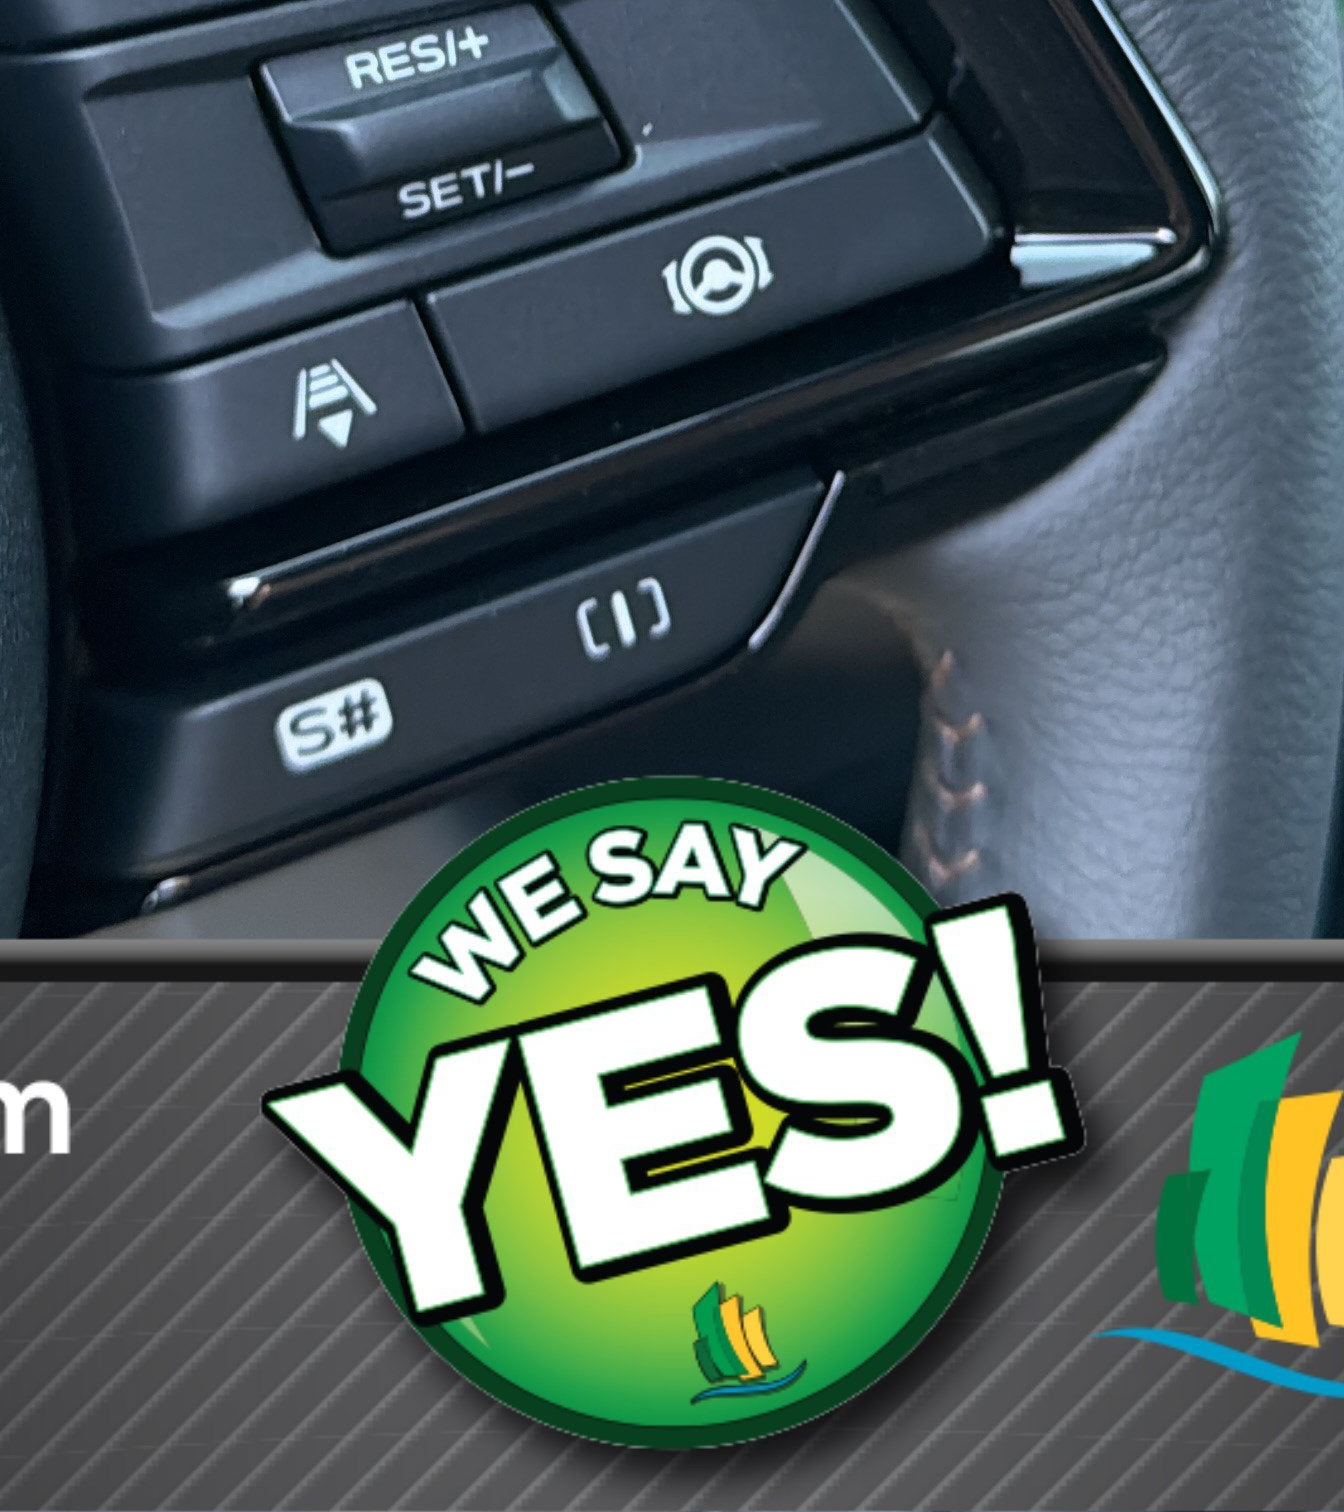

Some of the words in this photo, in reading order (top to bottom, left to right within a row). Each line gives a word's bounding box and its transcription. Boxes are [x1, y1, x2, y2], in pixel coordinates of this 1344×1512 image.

[346, 26, 489, 89] RES/+
[398, 159, 535, 219] SET/-
[289, 689, 379, 756] S#
